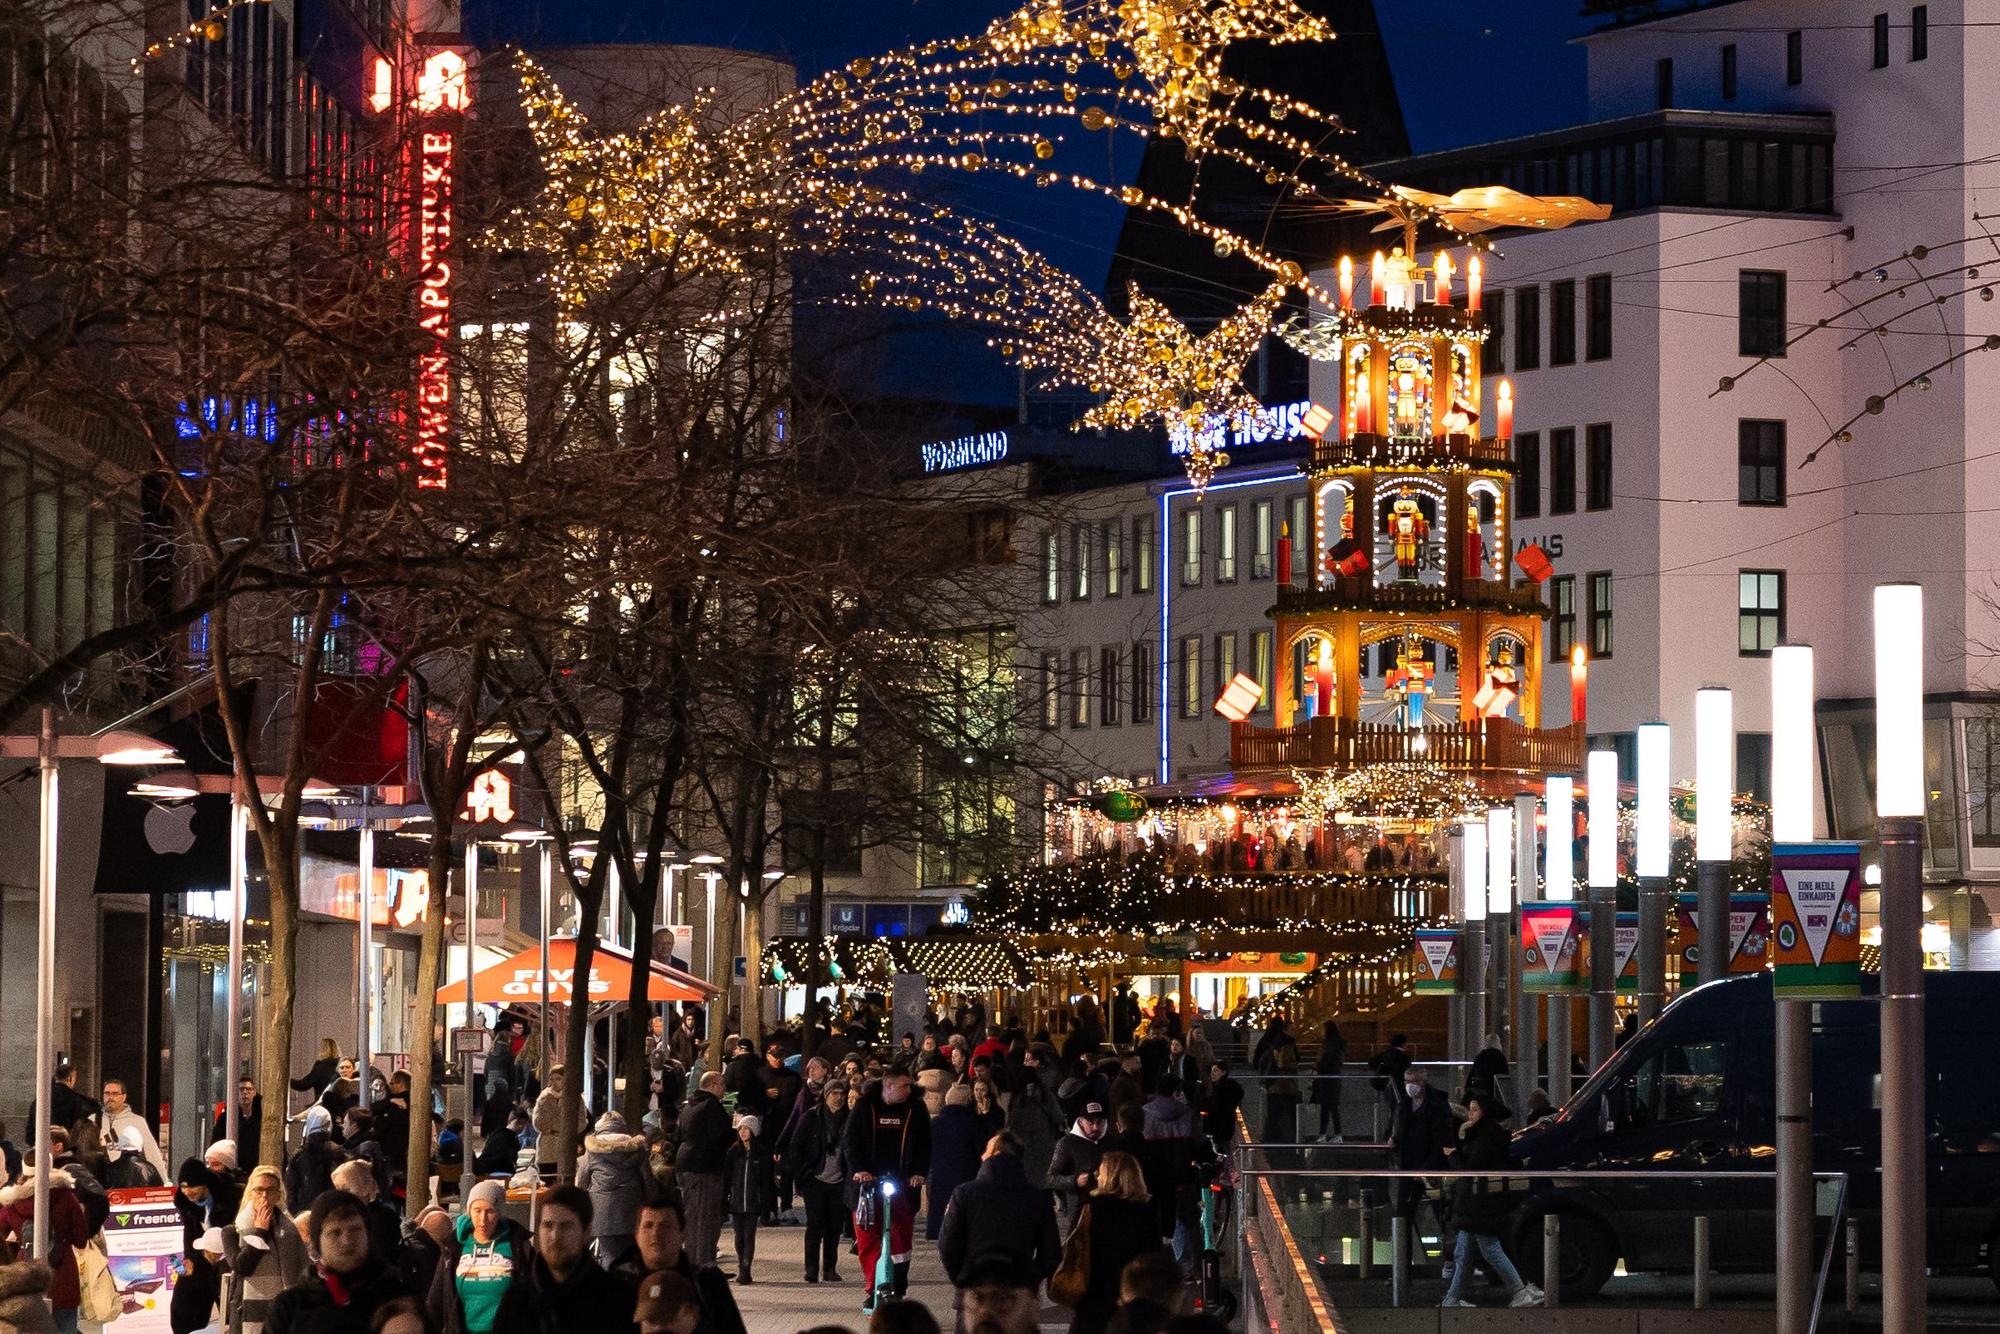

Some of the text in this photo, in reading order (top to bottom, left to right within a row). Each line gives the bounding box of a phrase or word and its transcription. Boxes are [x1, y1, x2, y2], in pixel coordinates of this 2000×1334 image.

[1798, 881, 1835, 890] EINE MEILE
[1798, 892, 1835, 900] EINKAUFEN
[502, 980, 609, 995] GUYS
[133, 1213, 181, 1225] freenet
